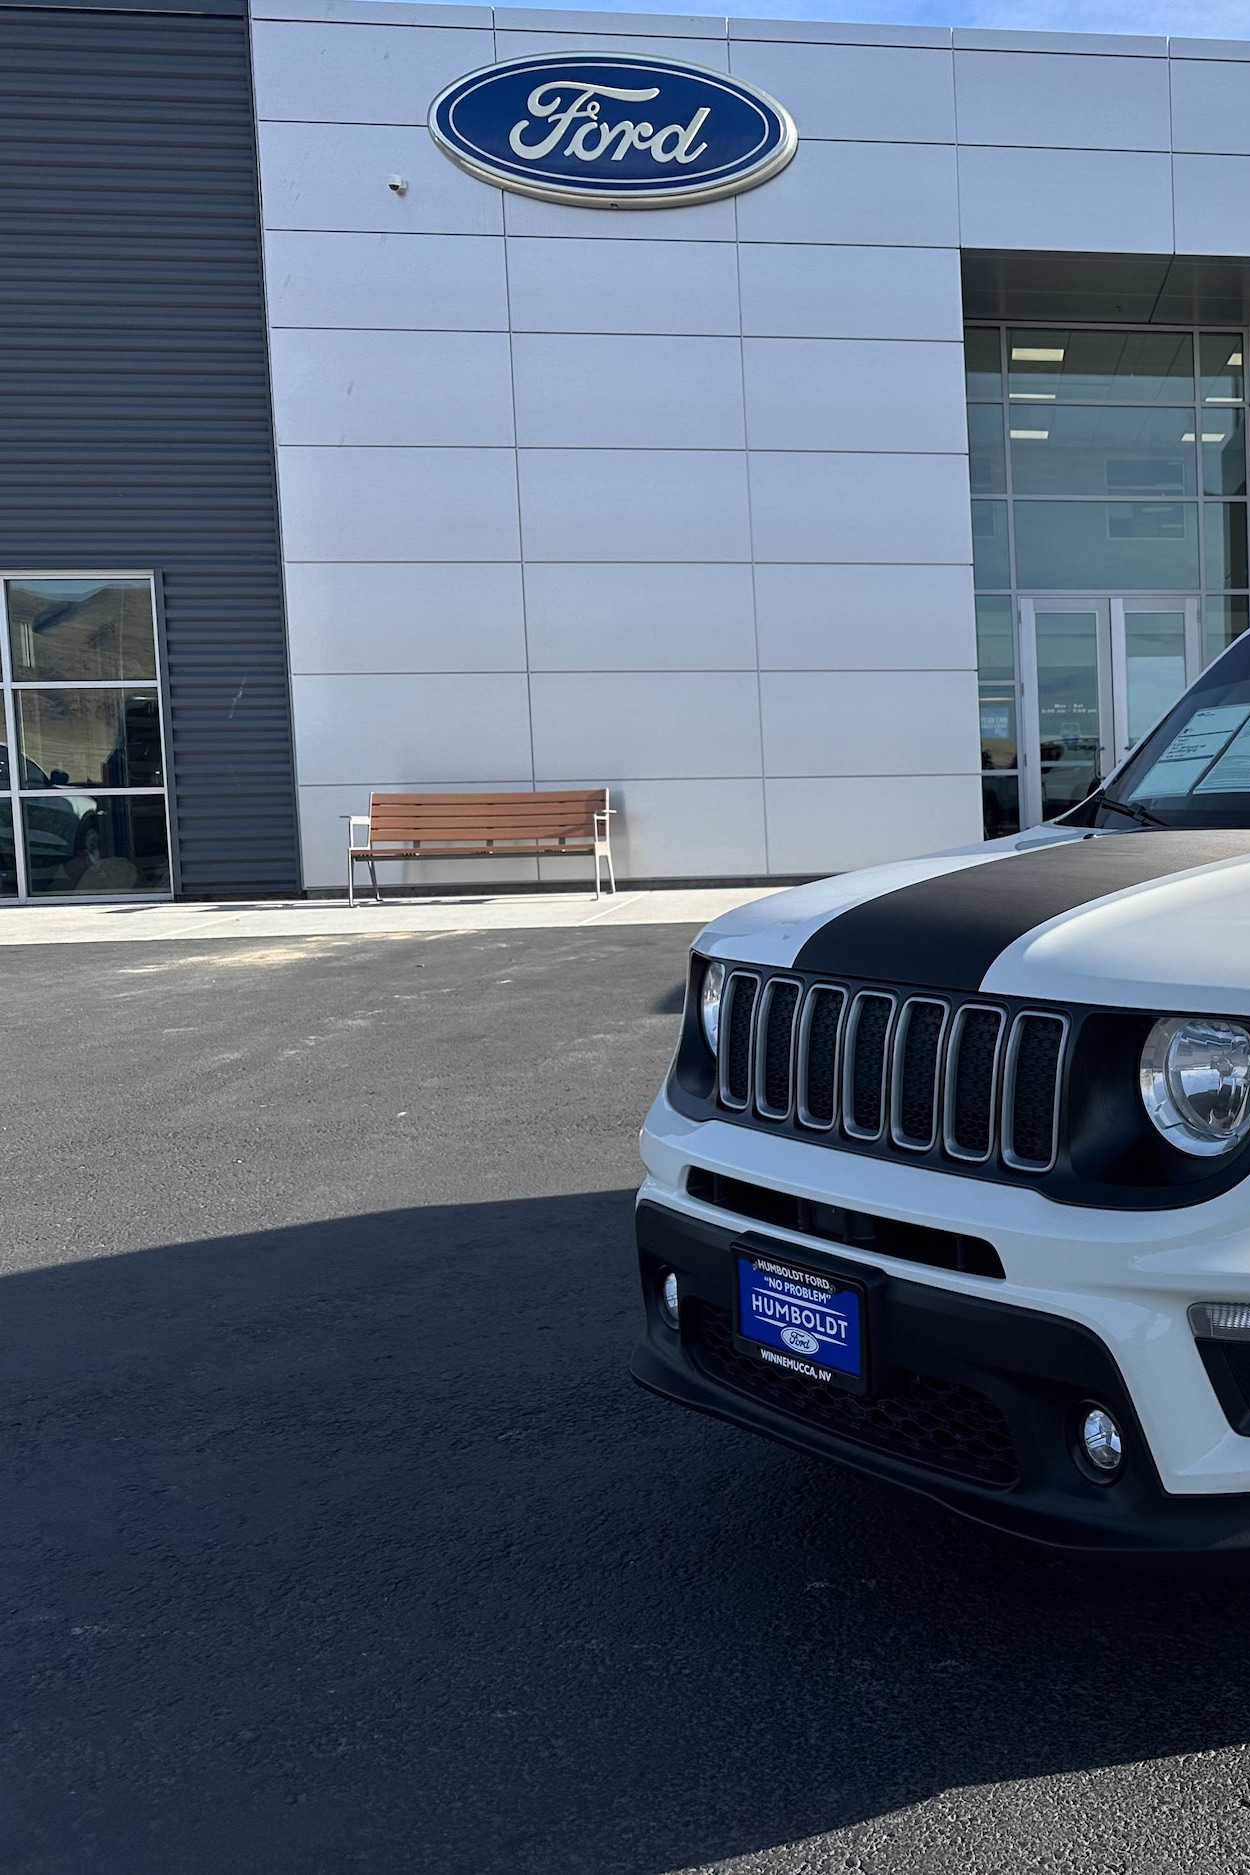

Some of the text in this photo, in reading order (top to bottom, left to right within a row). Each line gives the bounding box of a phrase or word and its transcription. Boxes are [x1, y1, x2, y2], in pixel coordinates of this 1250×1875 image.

[509, 80, 711, 165] Ford
[757, 1259, 830, 1290] HUMBOLDT FORD
[752, 1294, 848, 1339] HUMBOLDT
[789, 1331, 811, 1350] Ford
[760, 1349, 832, 1382] WINNEMUCCA, NV
